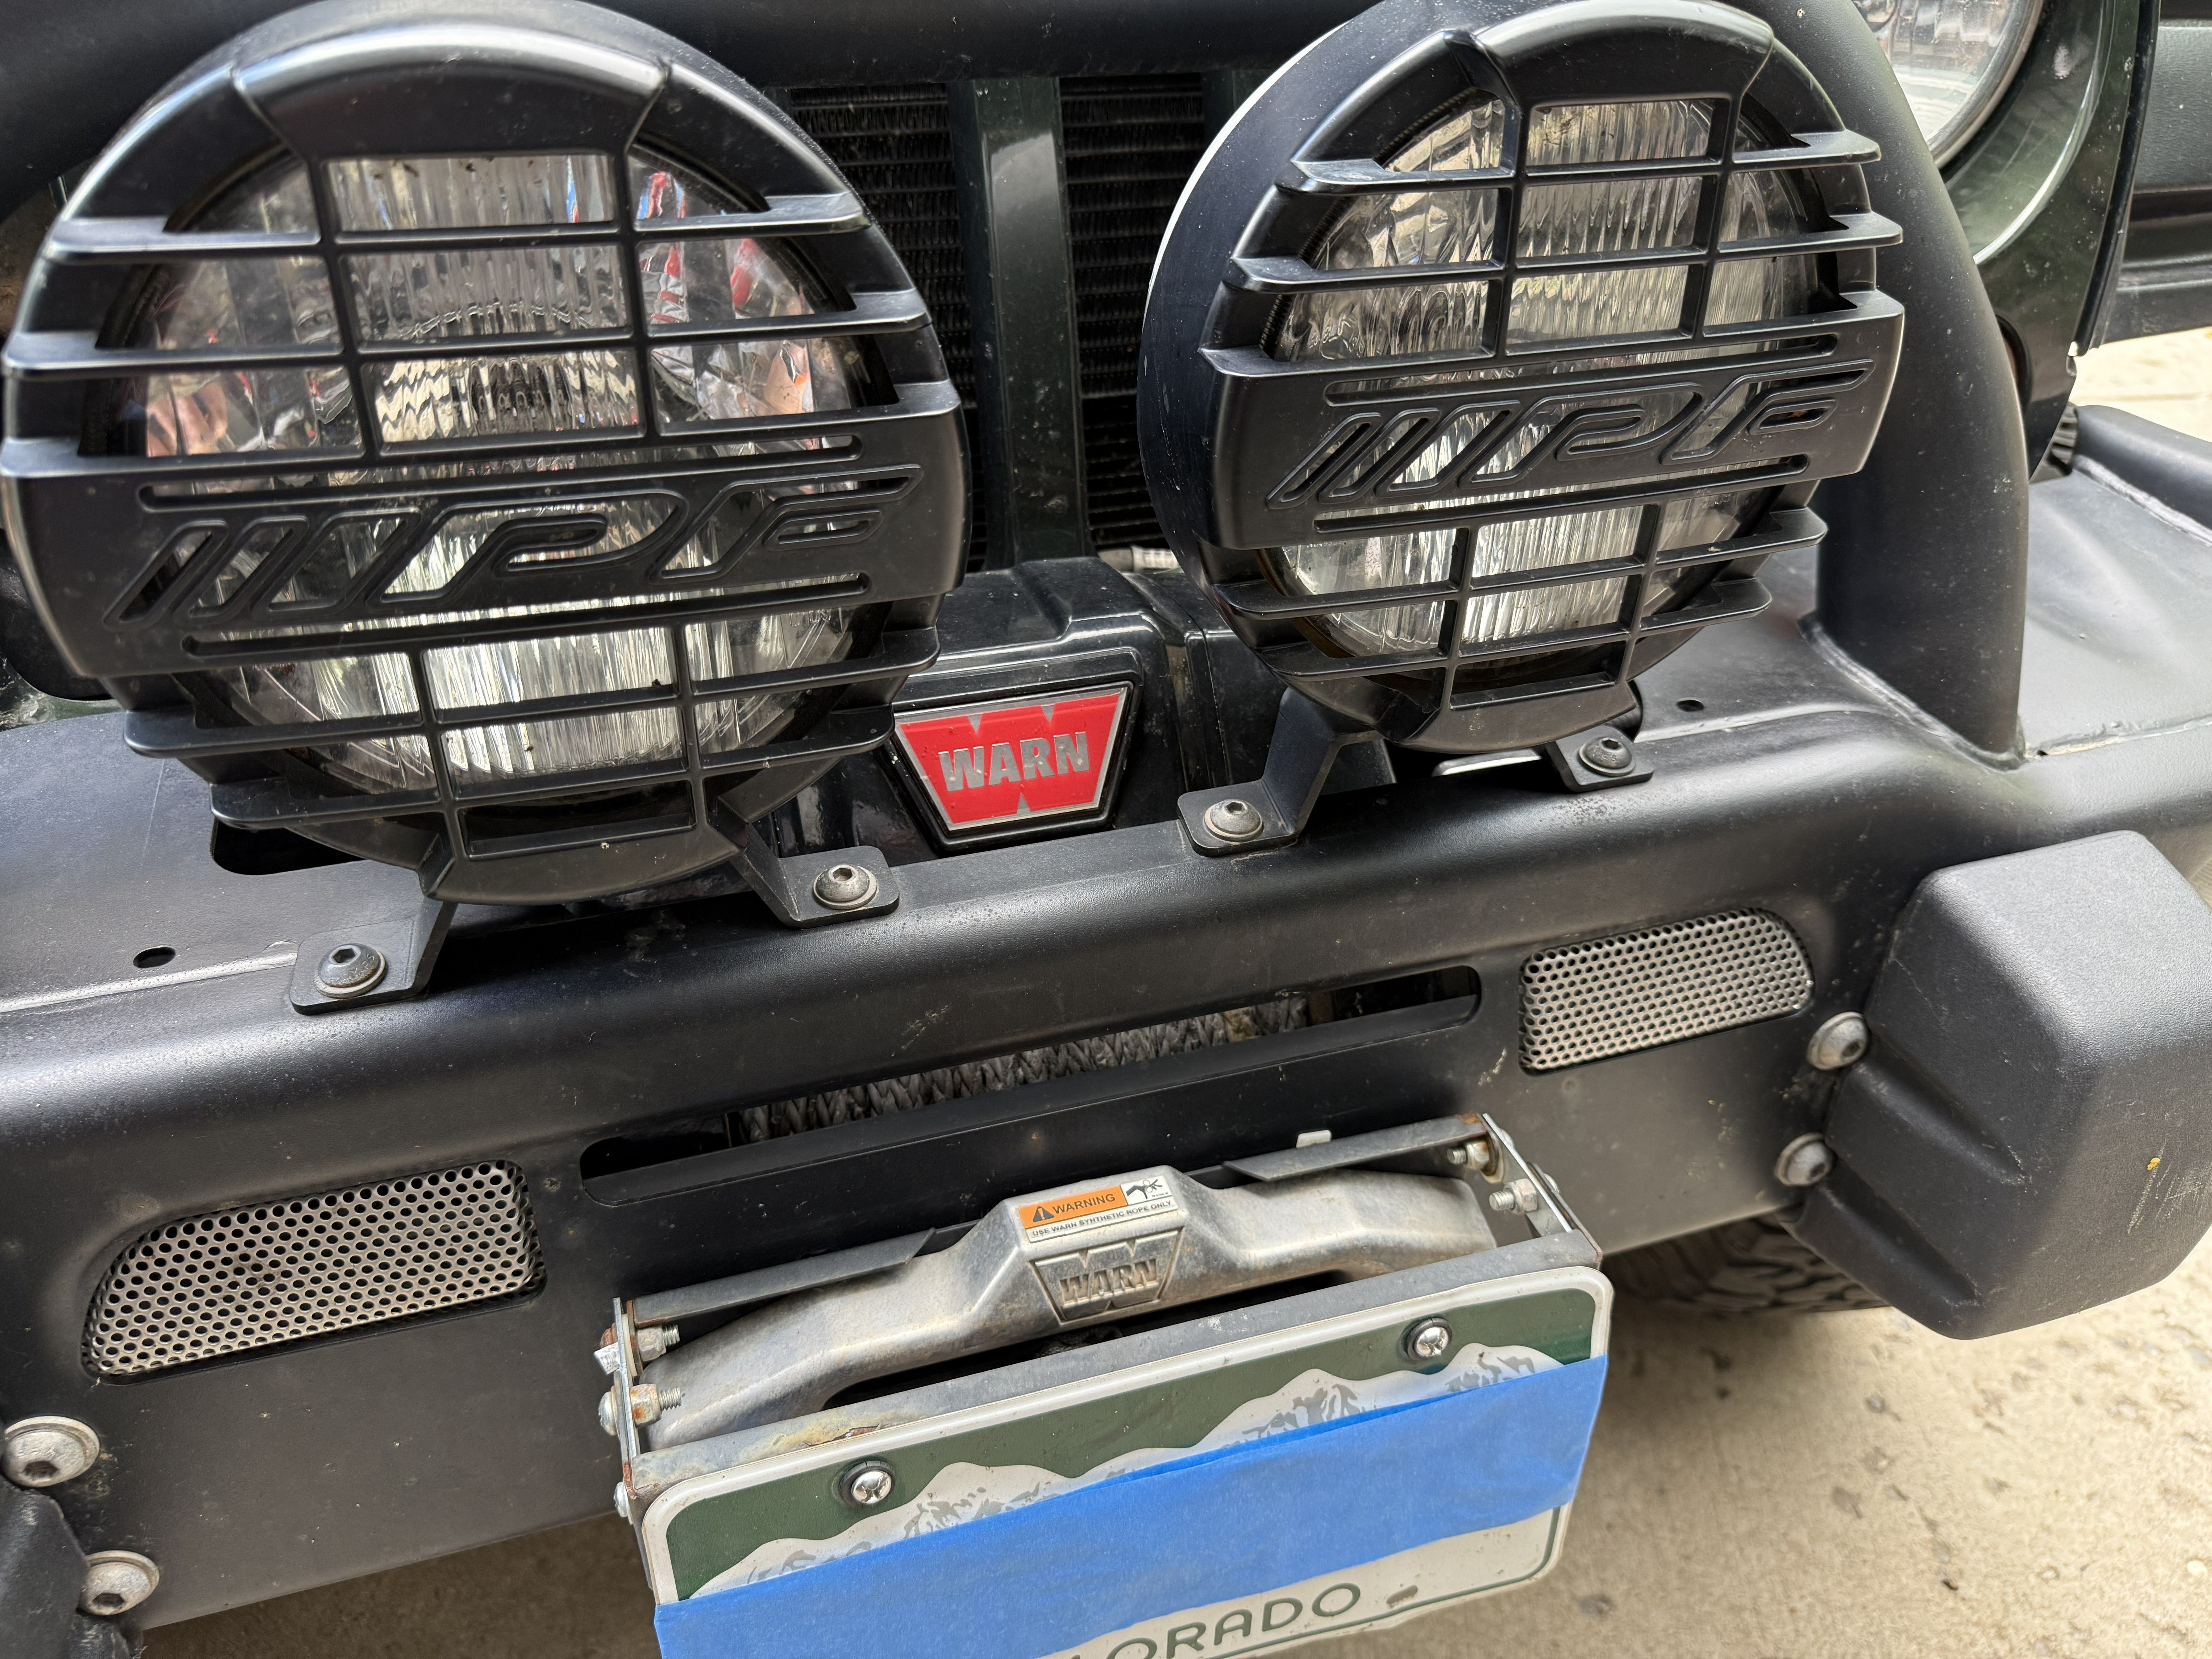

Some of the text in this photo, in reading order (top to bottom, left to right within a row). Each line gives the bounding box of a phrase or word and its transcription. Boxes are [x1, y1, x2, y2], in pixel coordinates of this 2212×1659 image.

[938, 732, 1090, 792] WARN
[1032, 1200, 1171, 1236] USE WARN SYNTHETIC ROPE ONLY
[1053, 1194, 1116, 1214] WARNING
[1060, 1259, 1159, 1307] WARN
[1070, 1582, 1360, 1659] ORADO
